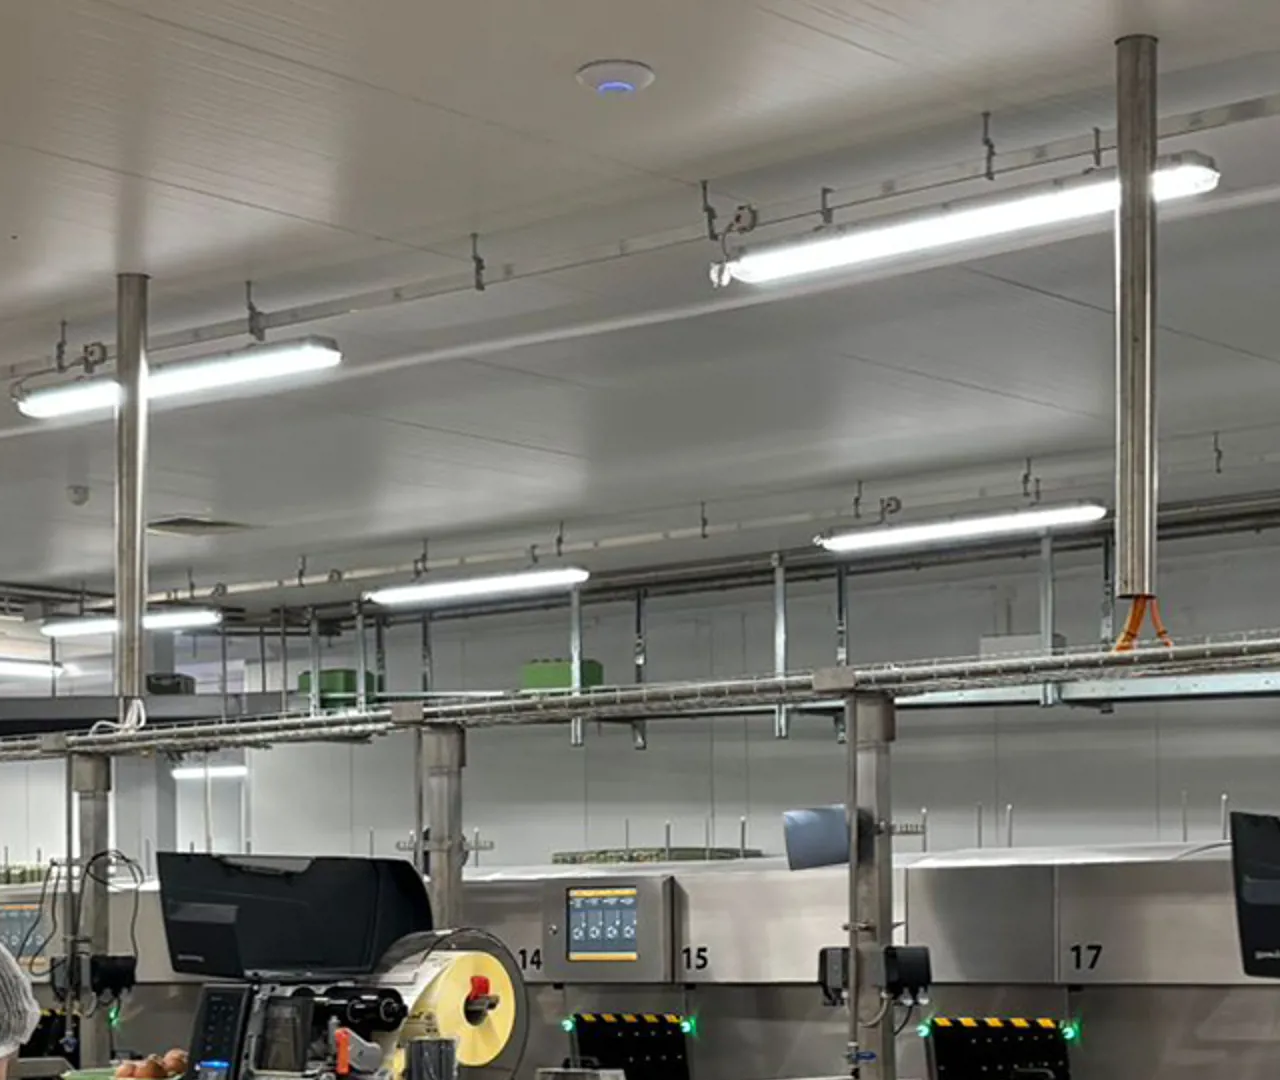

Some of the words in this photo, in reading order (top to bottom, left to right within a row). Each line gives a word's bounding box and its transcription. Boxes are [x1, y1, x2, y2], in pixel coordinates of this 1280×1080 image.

[519, 948, 543, 970] 14
[682, 947, 709, 970] 15
[1071, 944, 1103, 970] 17
